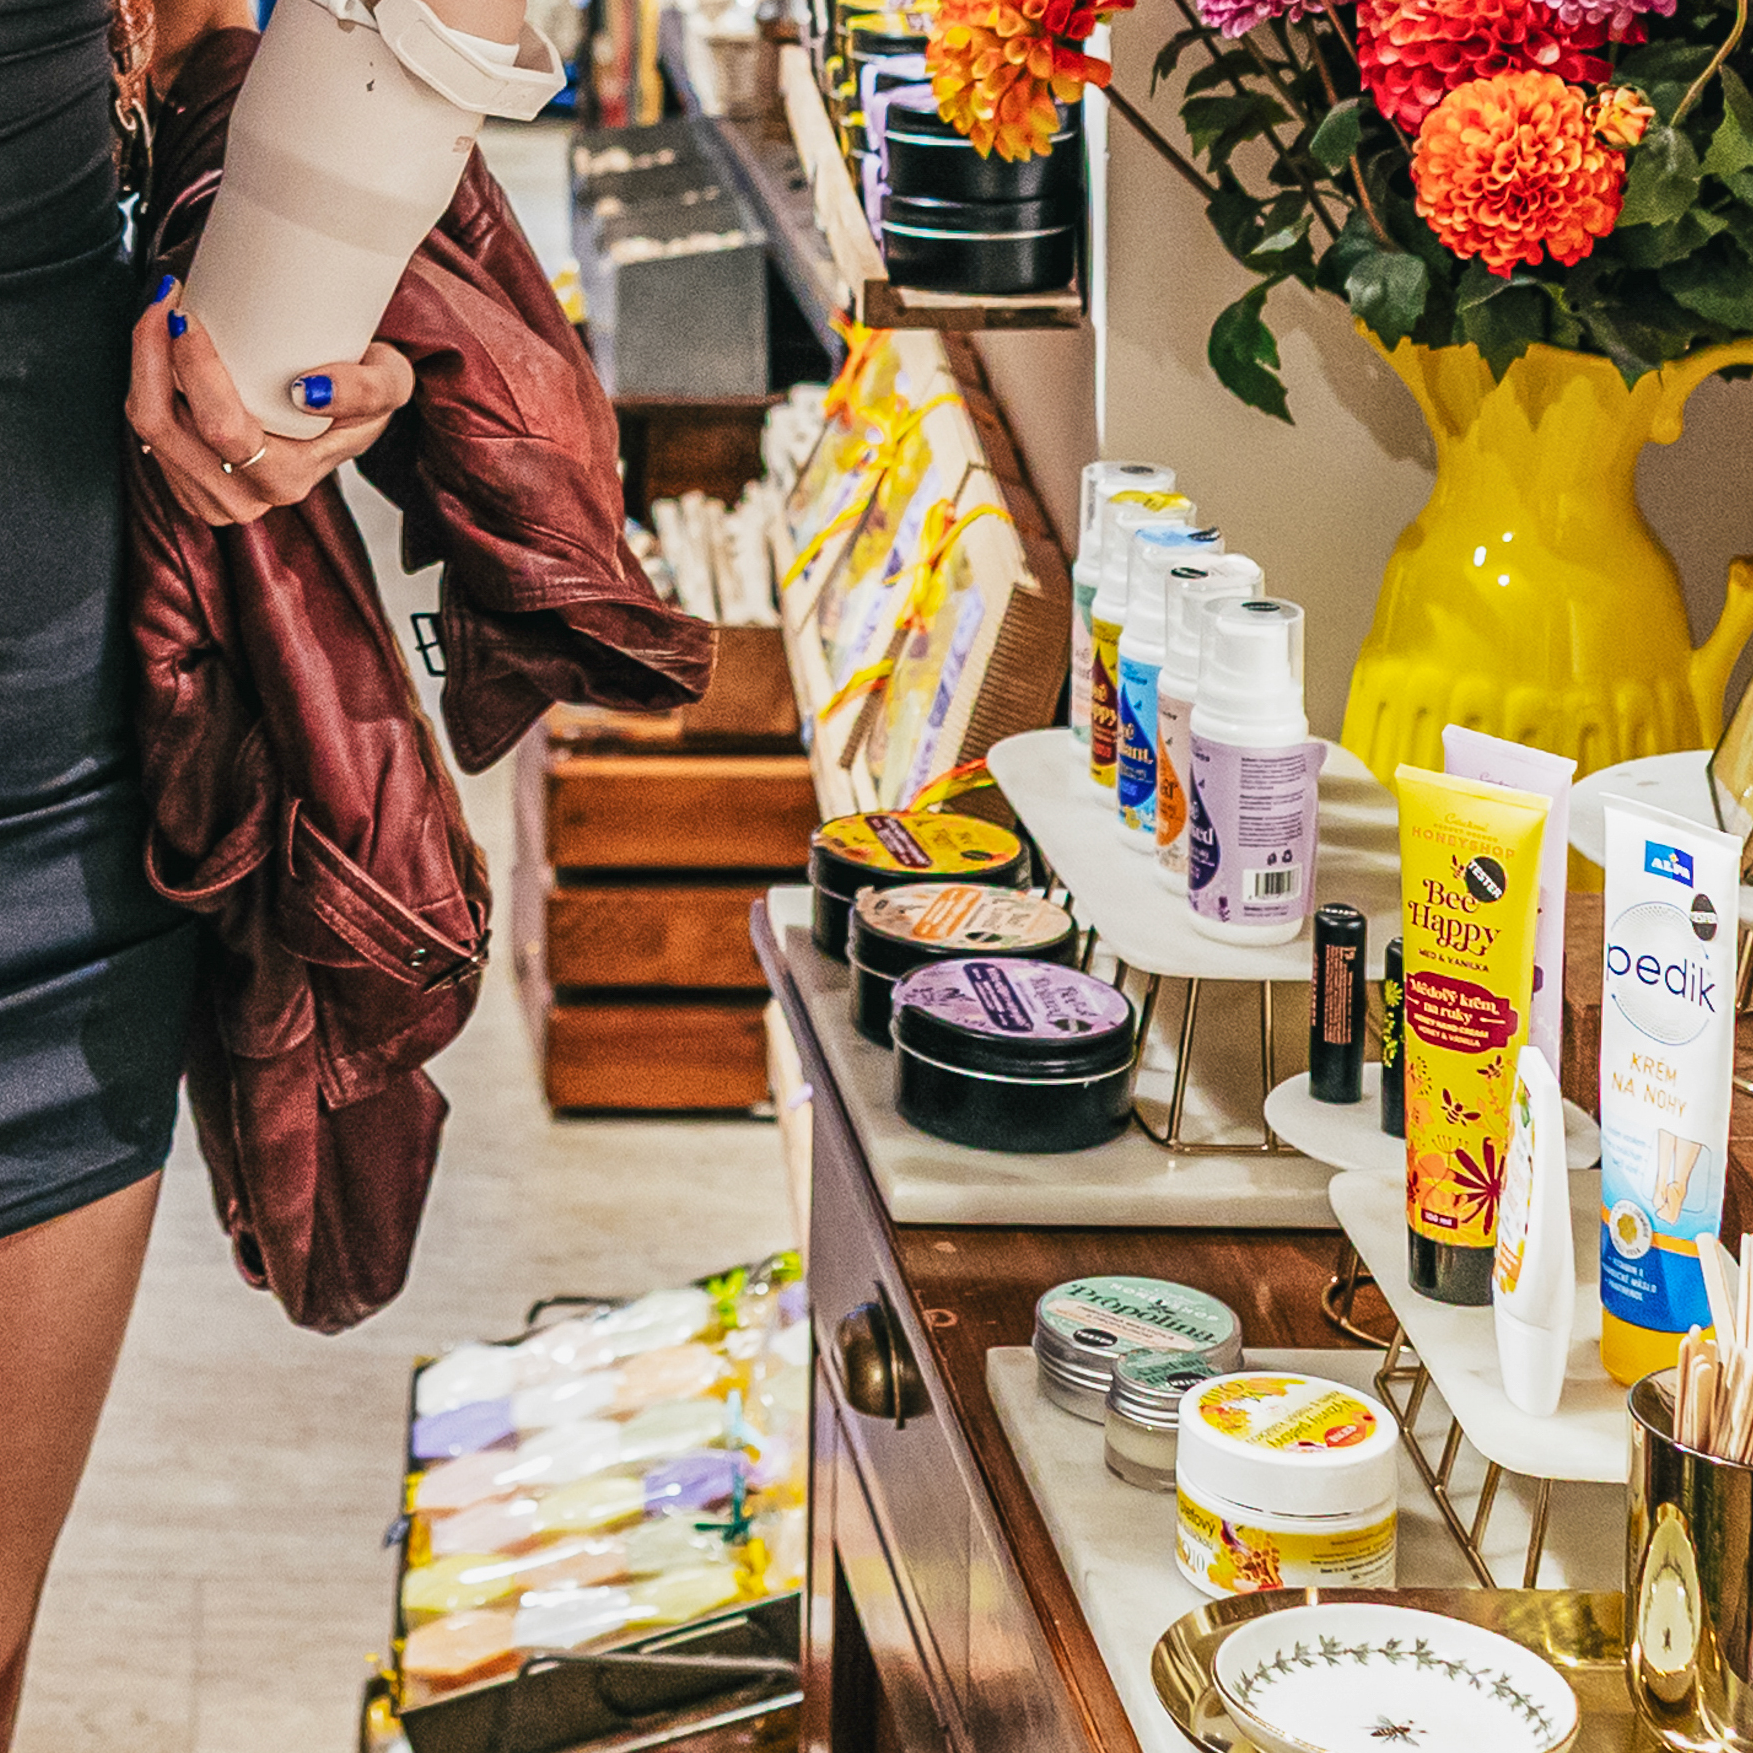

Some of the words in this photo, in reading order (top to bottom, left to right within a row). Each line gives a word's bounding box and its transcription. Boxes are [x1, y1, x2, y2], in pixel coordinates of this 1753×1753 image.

[1412, 826, 1515, 859] HONEYSHOP
[1422, 878, 1482, 914] Bee
[1466, 859, 1503, 899] TESTER
[1408, 900, 1502, 957] Happy
[1606, 943, 1716, 1014] pedik
[1423, 1002, 1438, 1015] na
[1440, 1007, 1473, 1026] ruky
[1630, 1051, 1677, 1088] KRÉM
[1611, 1072, 1636, 1097] NA
[1643, 1083, 1687, 1118] NOHY
[1066, 1284, 1218, 1345] Propolina
